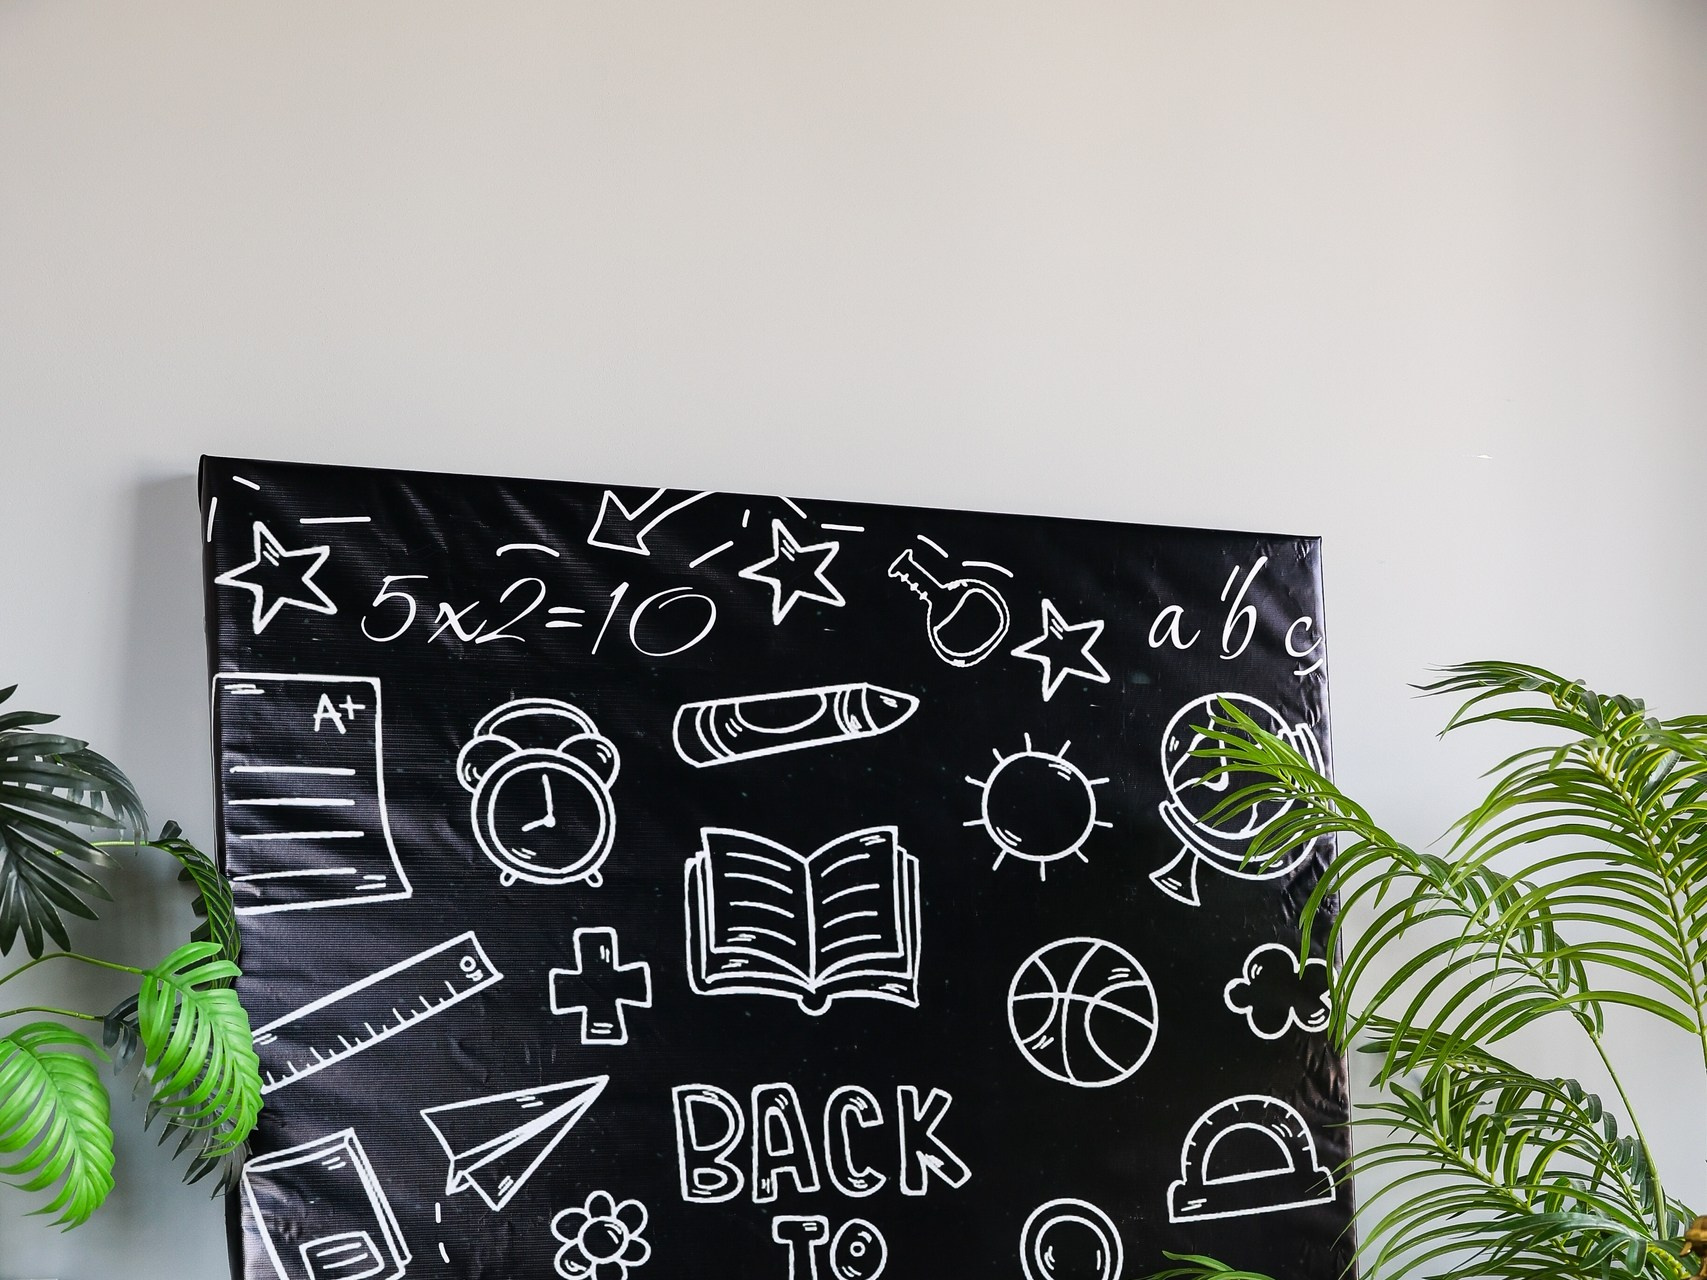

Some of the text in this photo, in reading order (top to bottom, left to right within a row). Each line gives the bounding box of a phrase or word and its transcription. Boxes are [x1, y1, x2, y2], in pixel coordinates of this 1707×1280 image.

[1147, 604, 1201, 651] a
[1283, 615, 1324, 659] c
[312, 693, 366, 735] A+
[672, 1082, 972, 1204] BACK
